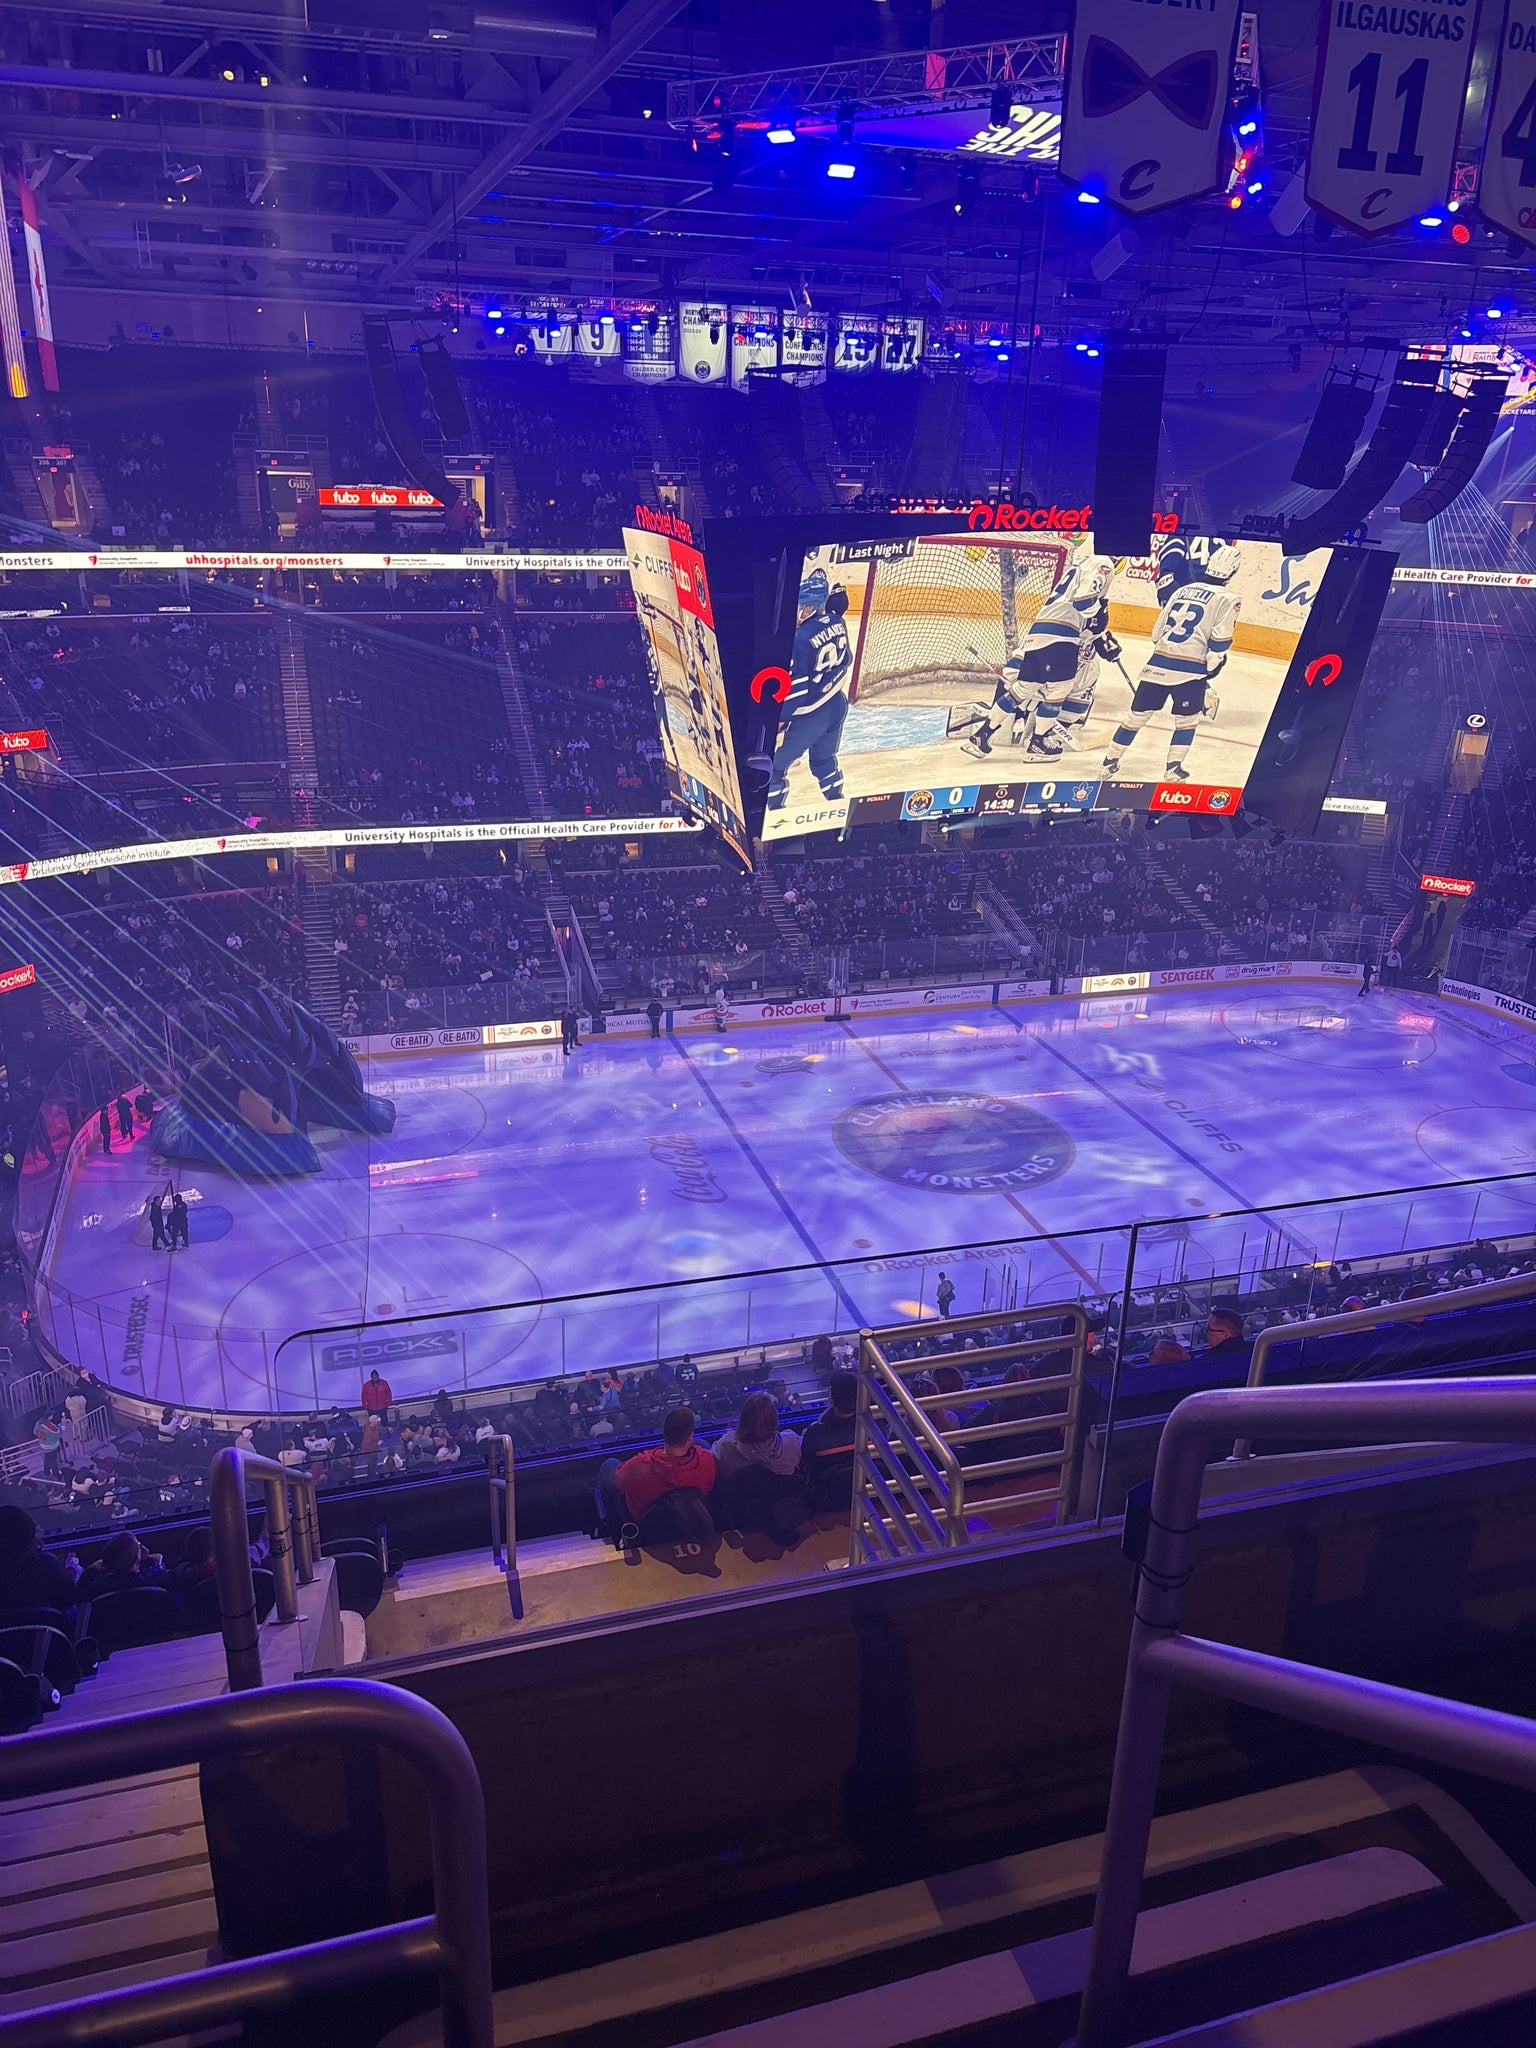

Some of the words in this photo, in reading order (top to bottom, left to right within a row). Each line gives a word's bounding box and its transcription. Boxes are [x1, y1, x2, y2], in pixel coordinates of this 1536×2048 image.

[1336, 1, 1466, 42] ILGAUSKAS
[1337, 52, 1430, 177] 11
[785, 341, 826, 351] CONFENCE
[786, 351, 824, 362] CHAMPIONS
[333, 491, 360, 504] fubo
[371, 491, 398, 504] fubo
[408, 491, 434, 504] fubo
[994, 504, 1093, 530] Rocket
[849, 547, 872, 559] Last
[873, 543, 905, 558] Night
[186, 554, 344, 569] uhhospitals.org/monsters
[465, 557, 520, 570] University
[523, 557, 571, 570] Hospitals
[574, 558, 583, 567] is
[585, 557, 603, 567] the
[645, 556, 675, 580] CLIFFS
[1125, 562, 1158, 582] candy
[1403, 570, 1437, 581] Health
[1440, 572, 1464, 582] Care
[1466, 573, 1513, 584] Provider
[1515, 575, 1533, 585] for
[1180, 587, 1213, 604] PINELLI
[3, 736, 30, 748] fubo
[867, 794, 891, 803] PENALTY
[948, 787, 963, 805] 0
[1041, 782, 1056, 800] 0
[1160, 791, 1192, 804] fubo
[984, 799, 1014, 810] 14:38
[795, 808, 847, 825] CLIFFS
[345, 831, 405, 844] University
[409, 829, 462, 843] Hospitals
[465, 827, 474, 837] is
[477, 826, 497, 836] the
[500, 824, 541, 836] Official
[543, 822, 580, 834] Health
[582, 821, 606, 832] Care
[610, 819, 654, 832] Provider
[658, 819, 674, 830] for
[100, 853, 137, 867] Medicine
[138, 848, 171, 861] Institute
[1433, 879, 1472, 893] Rocket
[0, 969, 33, 989] ocket
[1160, 967, 1215, 985] SEATGEEK
[1241, 967, 1257, 976] drug
[1259, 965, 1276, 973] mart
[1441, 981, 1481, 1001] Technologies
[776, 1001, 827, 1018] Rocket
[1494, 995, 1536, 1021] TRUSTED
[626, 1018, 652, 1027] MUTUA
[913, 1046, 970, 1056] Rocket
[852, 1095, 1006, 1127] CLEVELAND
[1164, 1100, 1244, 1152] CLIFFS
[902, 1154, 1056, 1189] MONSTERS
[884, 1251, 961, 1270] Rocket
[964, 1245, 1026, 1261] Arena
[673, 1543, 701, 1558] 10
